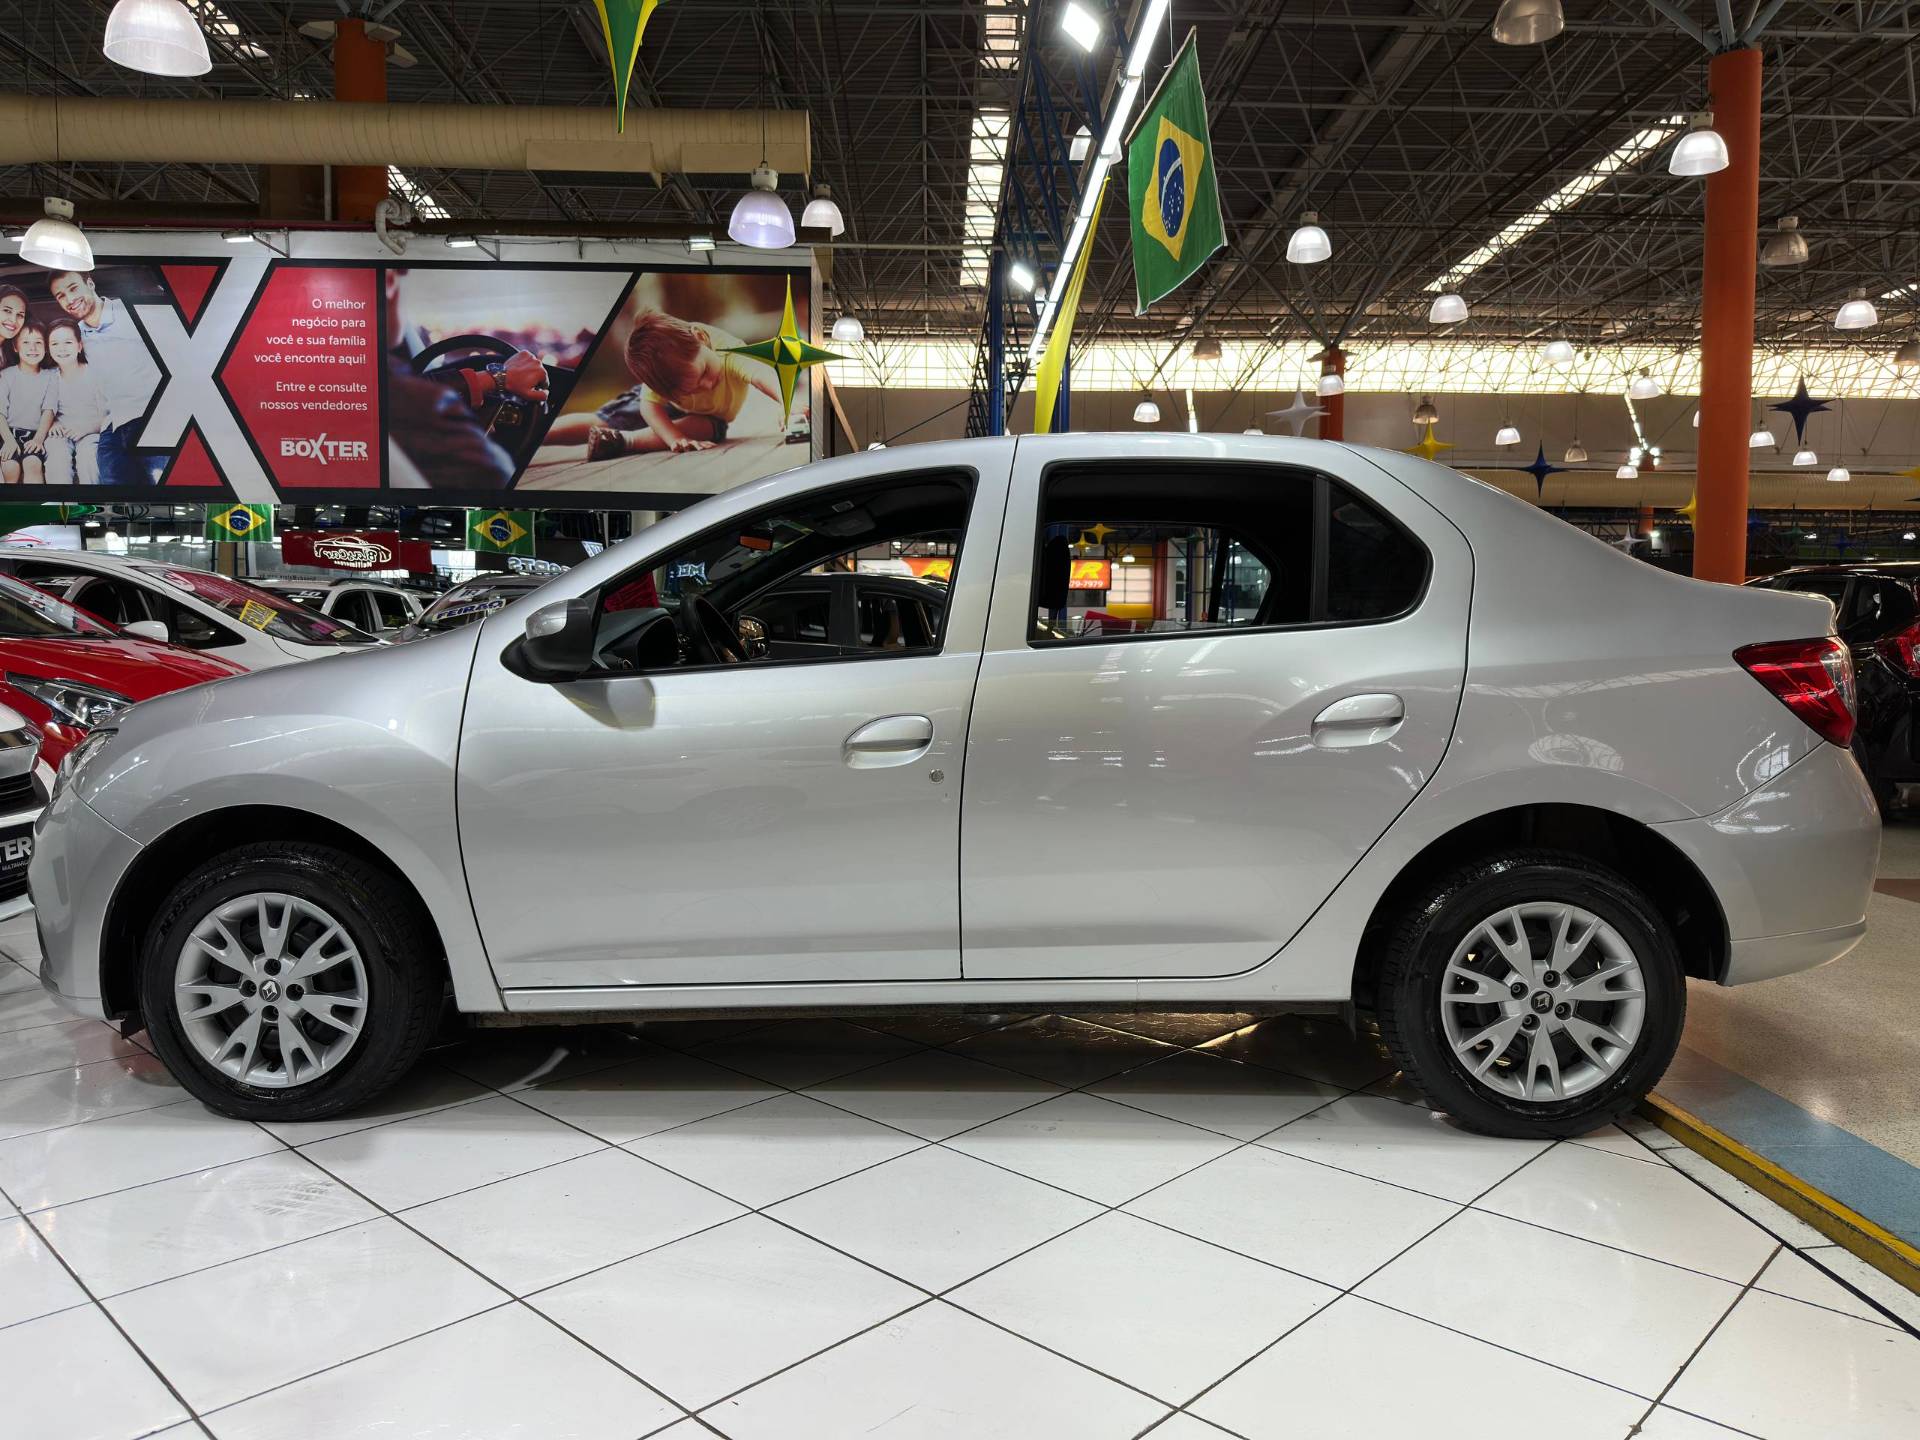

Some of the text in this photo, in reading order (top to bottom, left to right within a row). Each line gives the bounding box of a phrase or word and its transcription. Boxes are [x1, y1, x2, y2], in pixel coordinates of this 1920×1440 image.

[311, 298, 366, 309] O melhor
[292, 317, 366, 329] negócio para
[266, 334, 366, 346] você e sua família
[254, 353, 366, 366] você encontra aqui!
[276, 381, 367, 393] Entre e consulte
[260, 401, 368, 411] nossos vendedores
[281, 433, 368, 465] BOXTER
